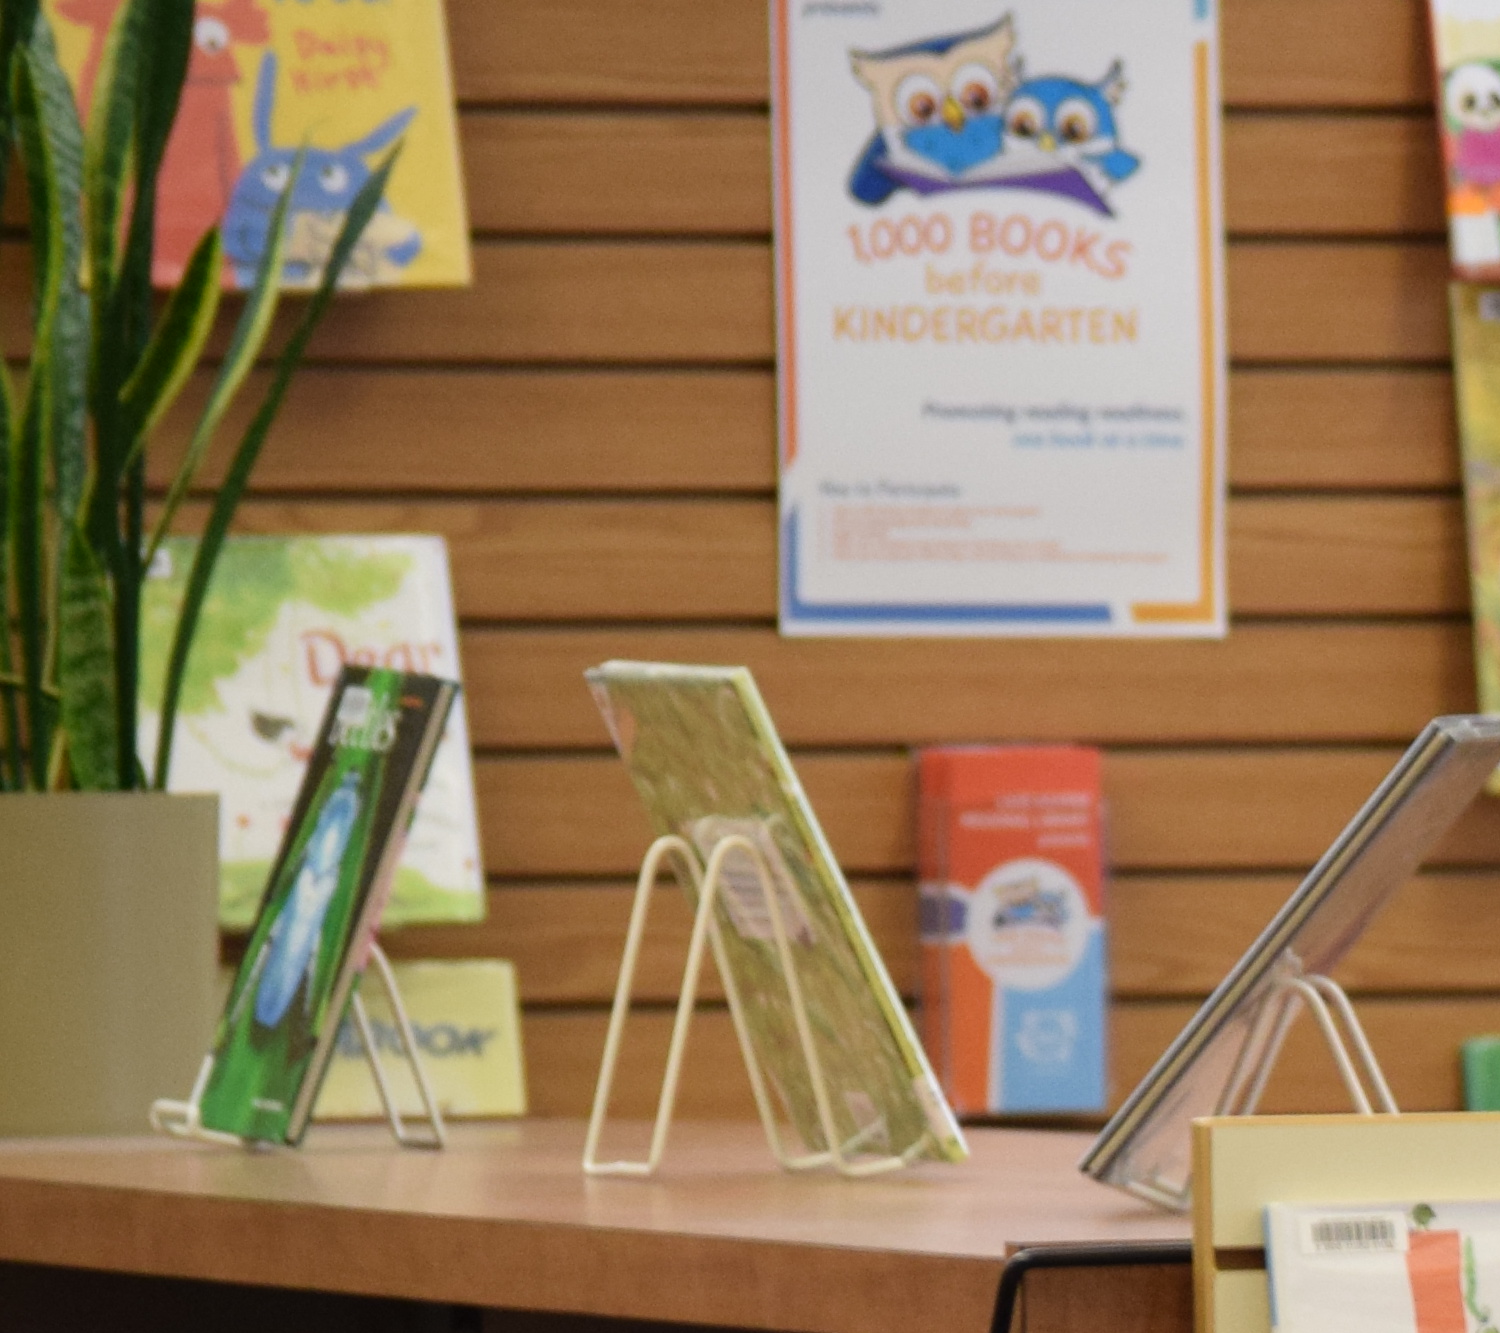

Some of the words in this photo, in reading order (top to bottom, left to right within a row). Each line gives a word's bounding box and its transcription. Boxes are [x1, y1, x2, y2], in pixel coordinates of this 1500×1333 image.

[847, 212, 953, 264] 1,000
[969, 211, 1132, 280] BOOKS
[925, 264, 1042, 297] before
[833, 306, 1140, 345] KINDERGARTEN
